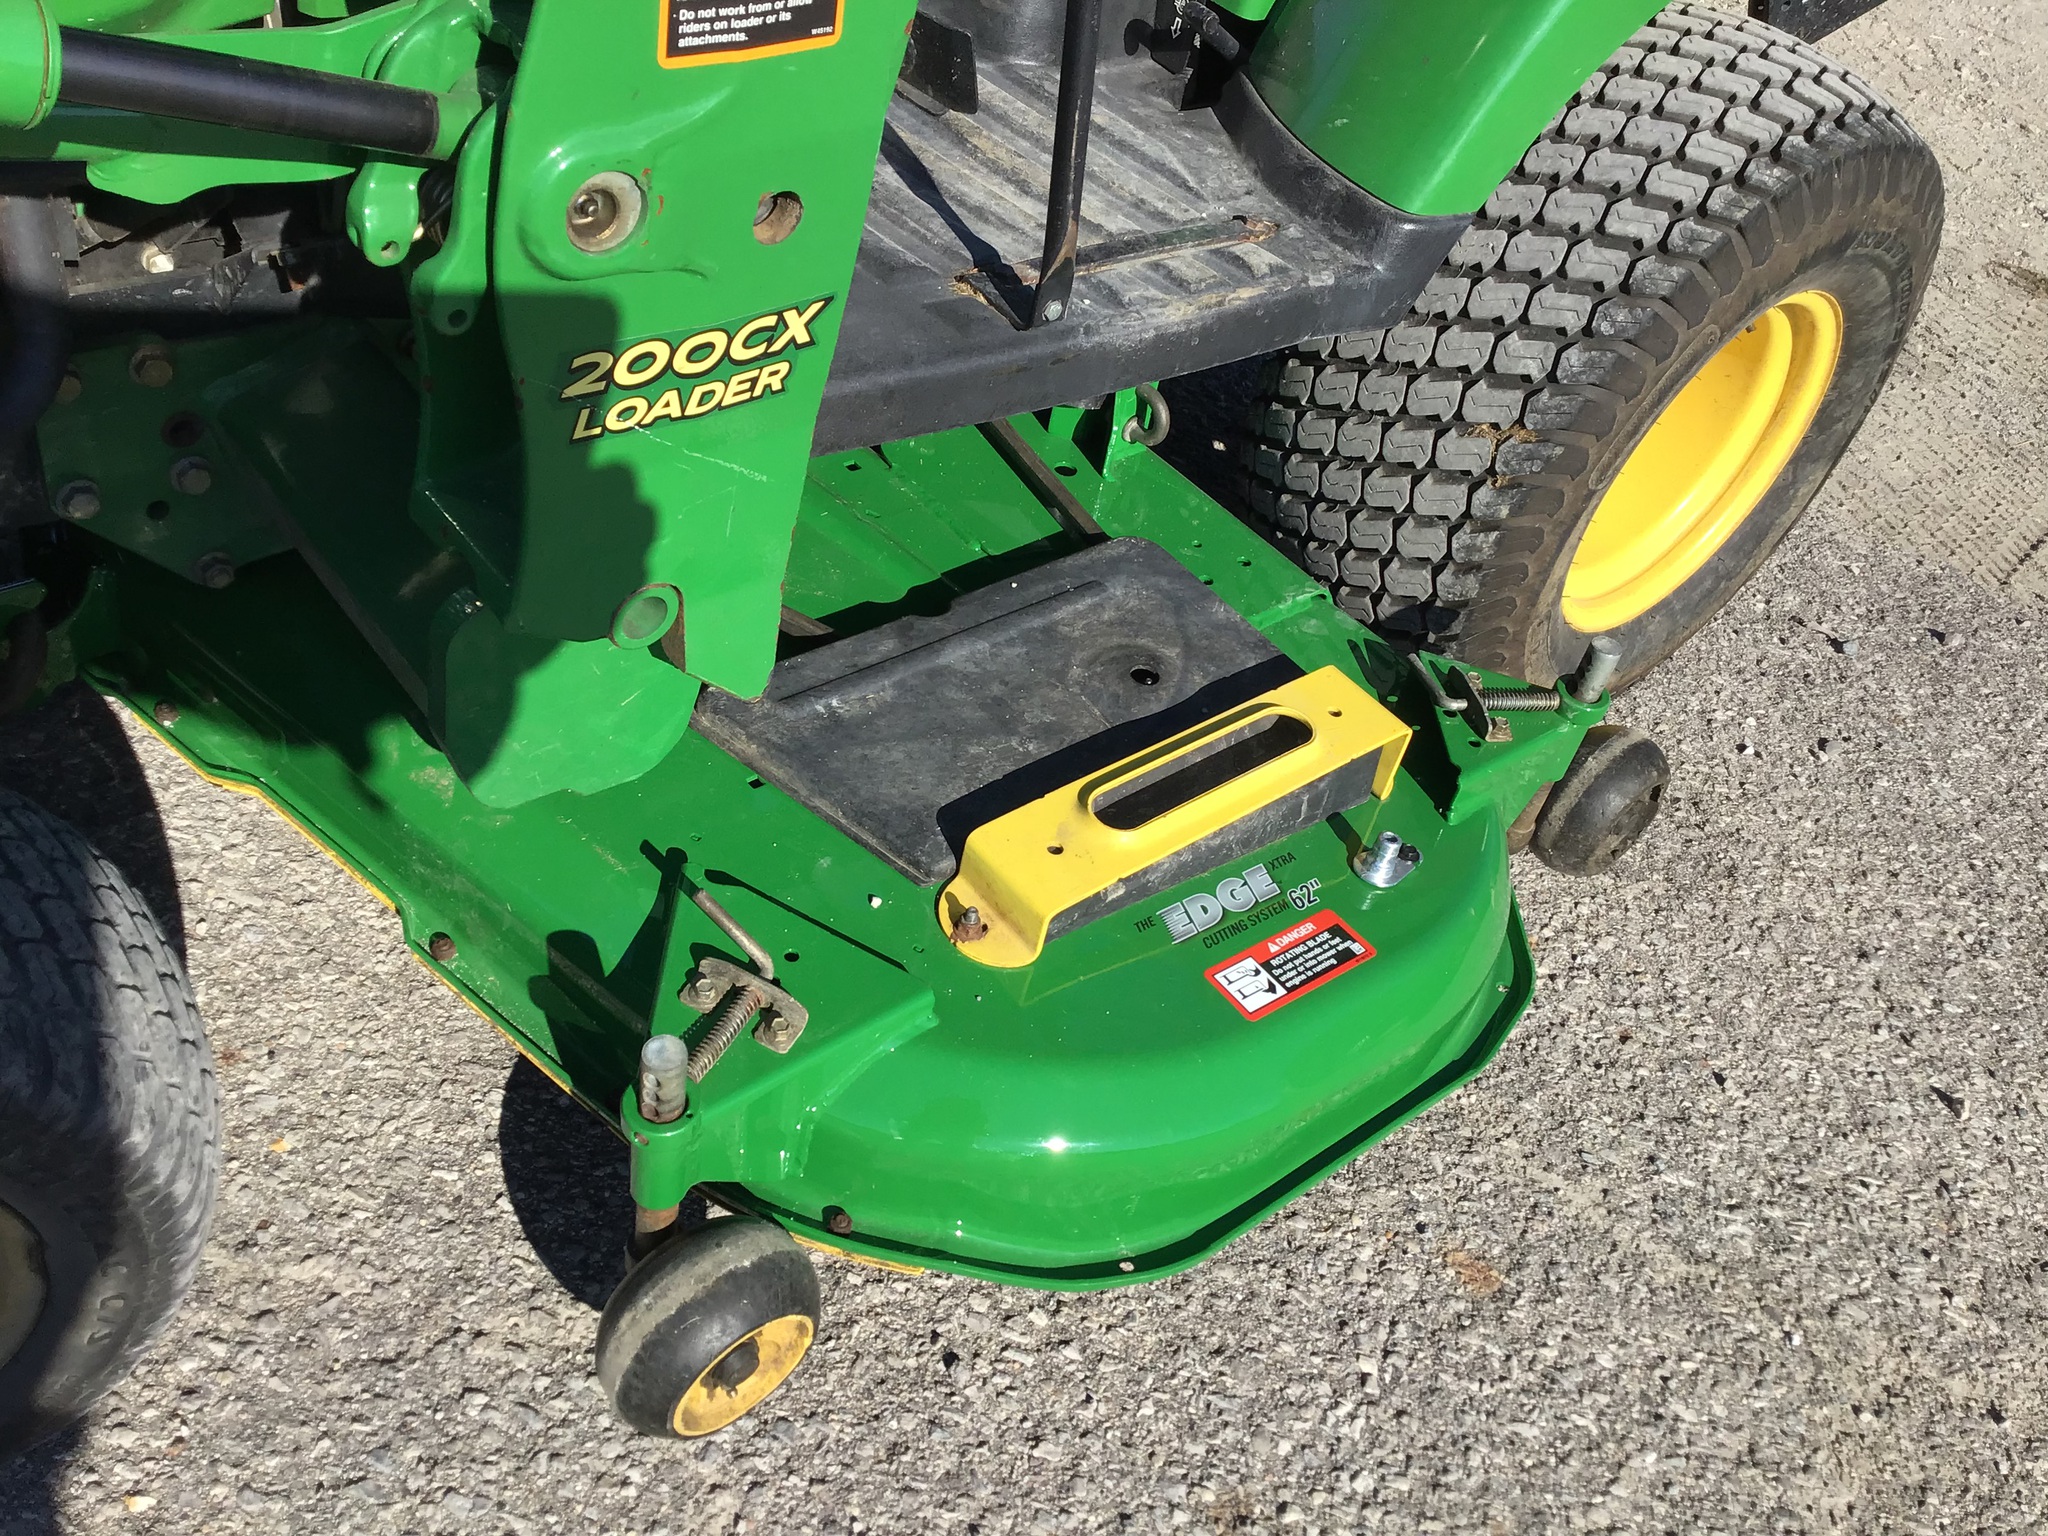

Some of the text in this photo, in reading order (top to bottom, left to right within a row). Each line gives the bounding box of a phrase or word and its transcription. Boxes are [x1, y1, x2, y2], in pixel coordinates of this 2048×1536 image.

[678, 11, 792, 34] riders on loader or its
[680, 10, 694, 20] Do
[698, 8, 716, 18] not
[718, 6, 746, 16] work
[748, 2, 772, 14] from
[774, 0, 786, 10] or
[678, 32, 749, 48] attachments.
[561, 296, 833, 400] 200CX
[571, 361, 791, 442] LOADER
[1134, 852, 1297, 944] THE EDGE XTRA
[1203, 877, 1322, 949] CUTTING SYSTEM 62"
[1270, 931, 1332, 967] ROTATING BLADE
[1275, 922, 1317, 948] DANGER
[1272, 966, 1283, 976] Do
[1282, 962, 1294, 971] not
[1293, 956, 1305, 967] put
[1303, 946, 1323, 960] hands
[1329, 937, 1342, 946] feet
[1279, 970, 1297, 982] under
[1303, 958, 1318, 969] into
[1317, 949, 1337, 962] mower
[1336, 940, 1354, 951] when
[1285, 958, 1338, 988] engine is running
